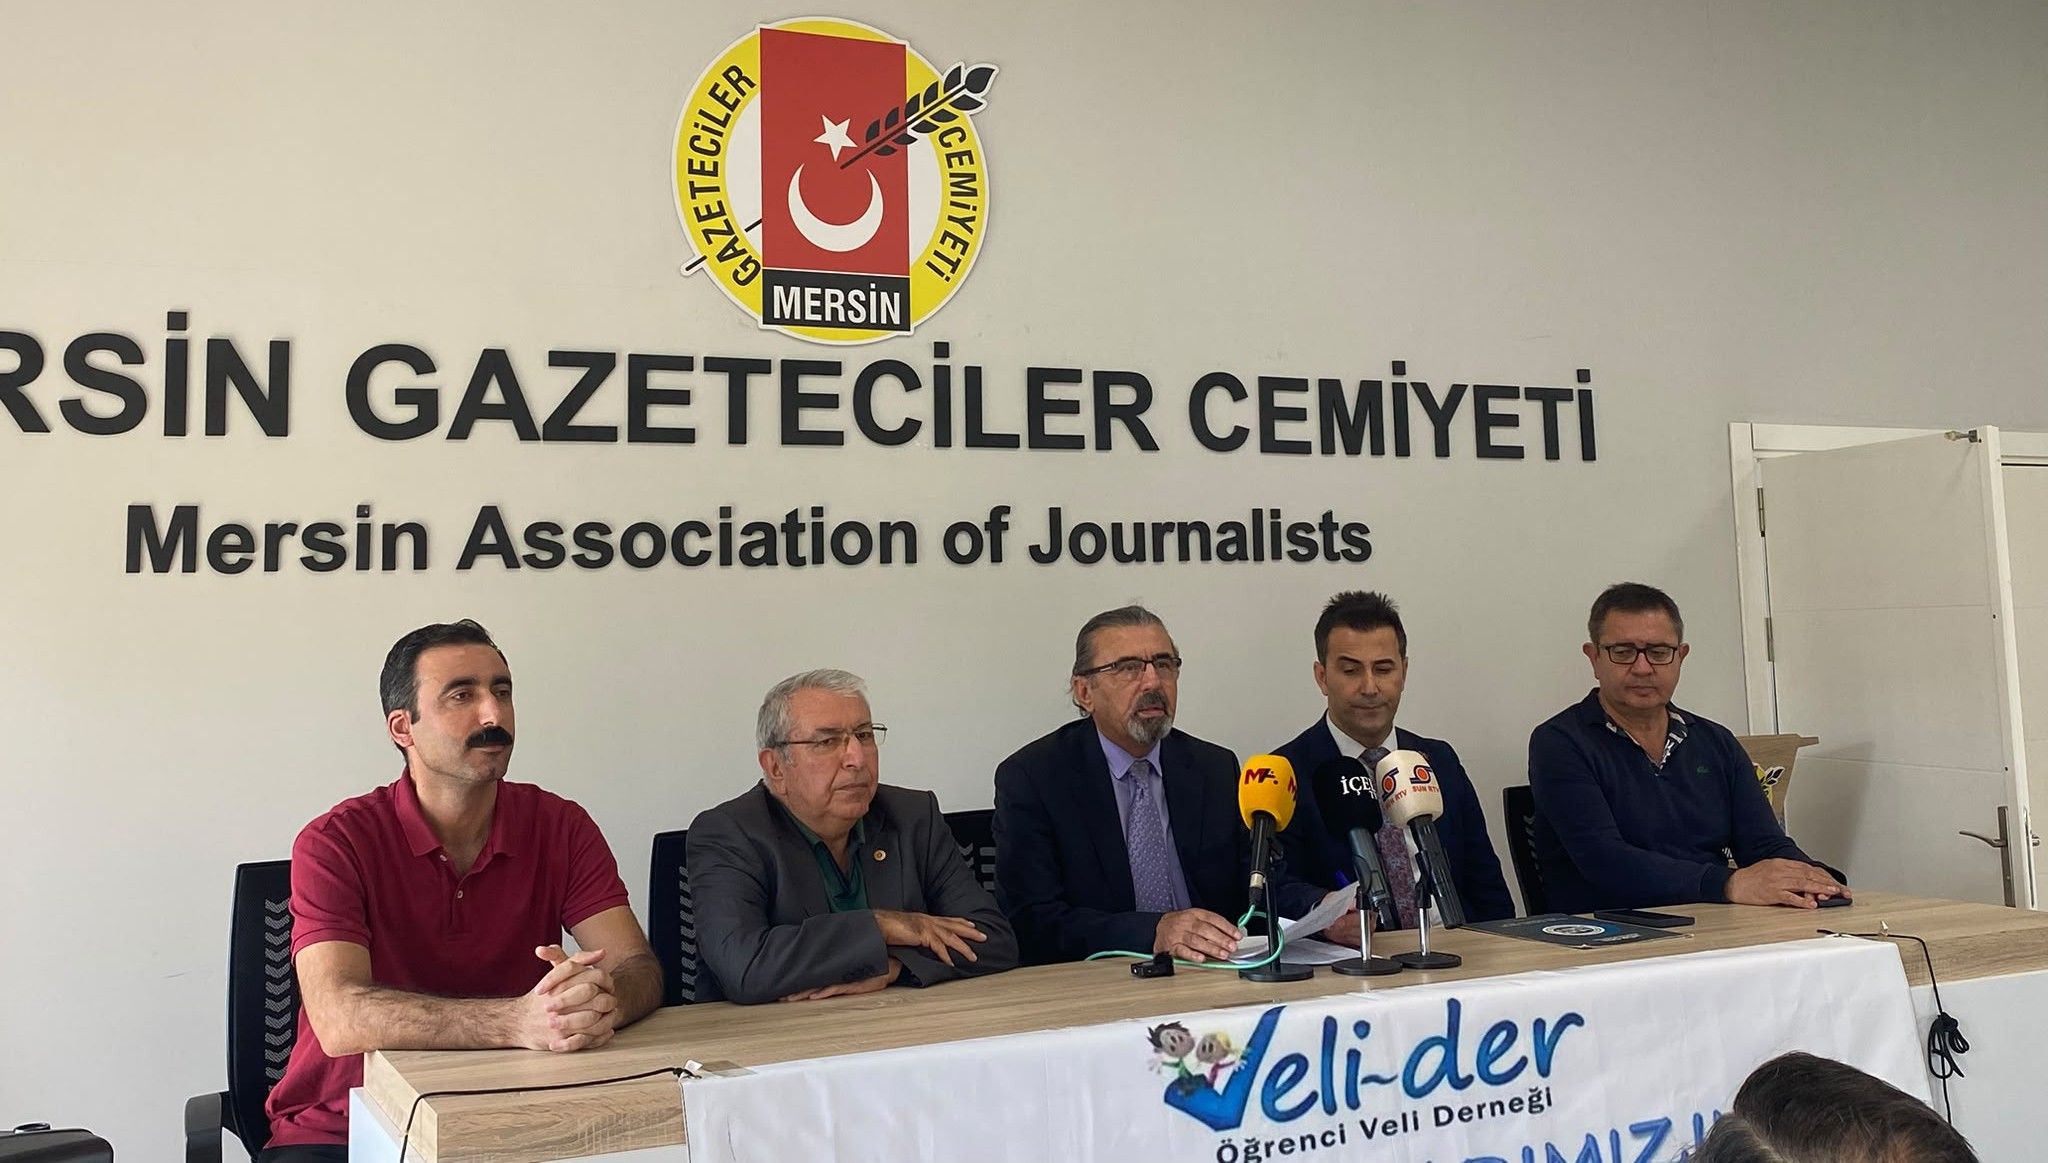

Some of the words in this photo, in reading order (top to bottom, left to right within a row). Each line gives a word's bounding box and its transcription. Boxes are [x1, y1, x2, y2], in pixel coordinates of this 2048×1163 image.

[688, 64, 761, 286] GAZETECİLER
[926, 122, 979, 283] CEMİYETİ
[772, 283, 901, 325] MERSİN
[345, 342, 1160, 453] GAZETECİLER
[1188, 360, 1597, 462] CEMİYETİ
[125, 503, 429, 574] Mersin
[456, 505, 919, 570] Association
[942, 505, 1012, 565] of
[1028, 507, 1373, 566] Journalists
[1215, 1122, 1347, 1163] Öğrenci
[1359, 1109, 1420, 1141] Veli
[1433, 1086, 1553, 1128] Derneği
